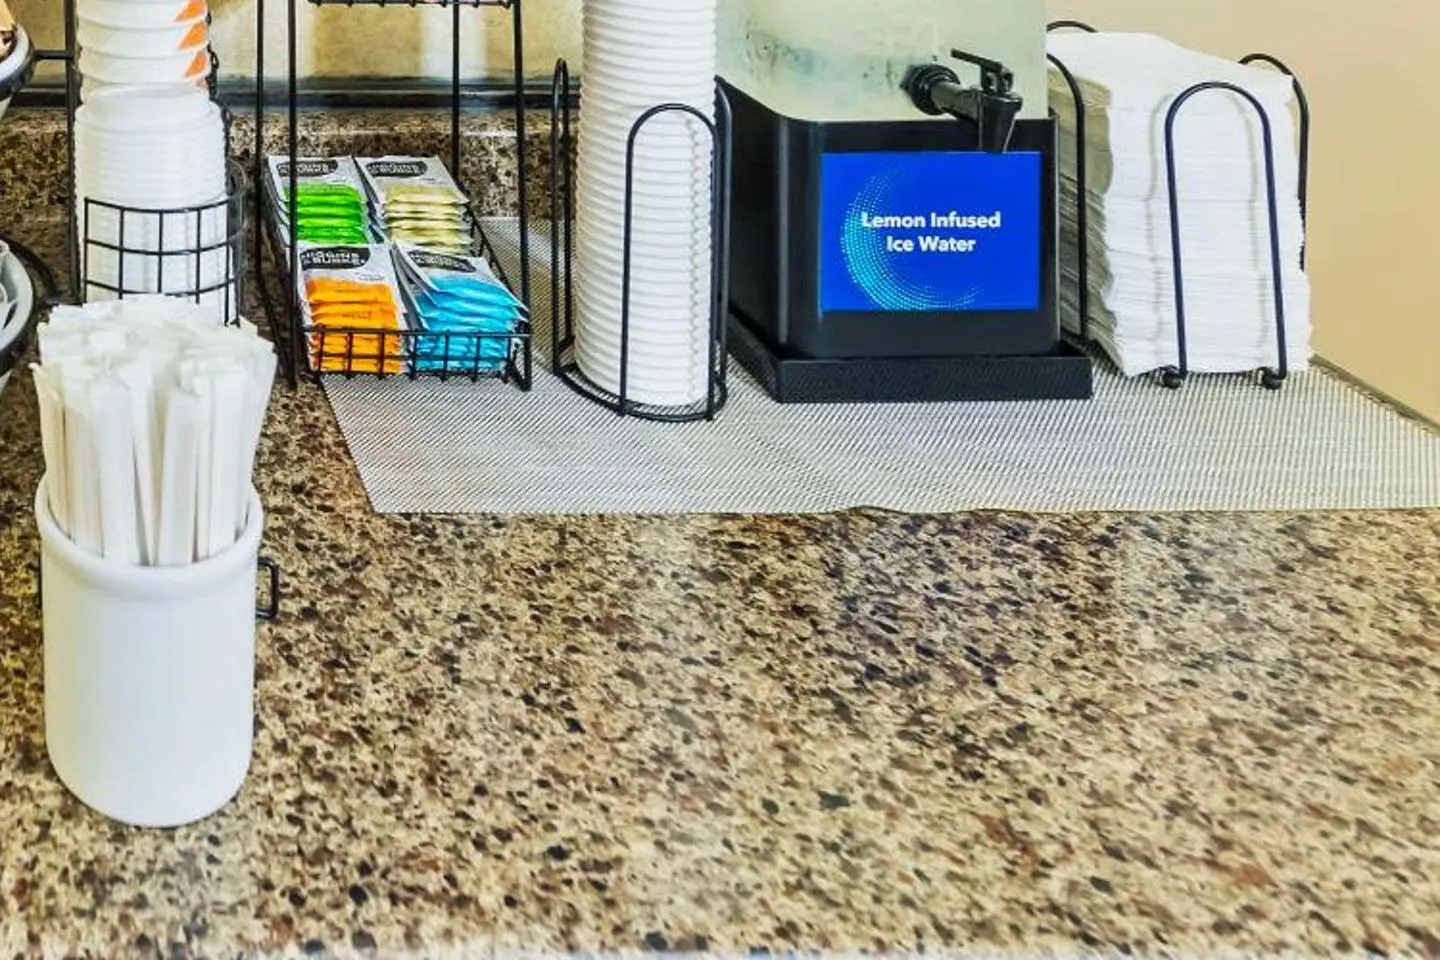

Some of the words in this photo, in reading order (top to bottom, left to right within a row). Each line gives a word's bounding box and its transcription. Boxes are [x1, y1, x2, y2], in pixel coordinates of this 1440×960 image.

[861, 211, 926, 228] Lemon
[930, 210, 1002, 228] Infused
[886, 236, 915, 252] Ice
[918, 236, 977, 253] Water
